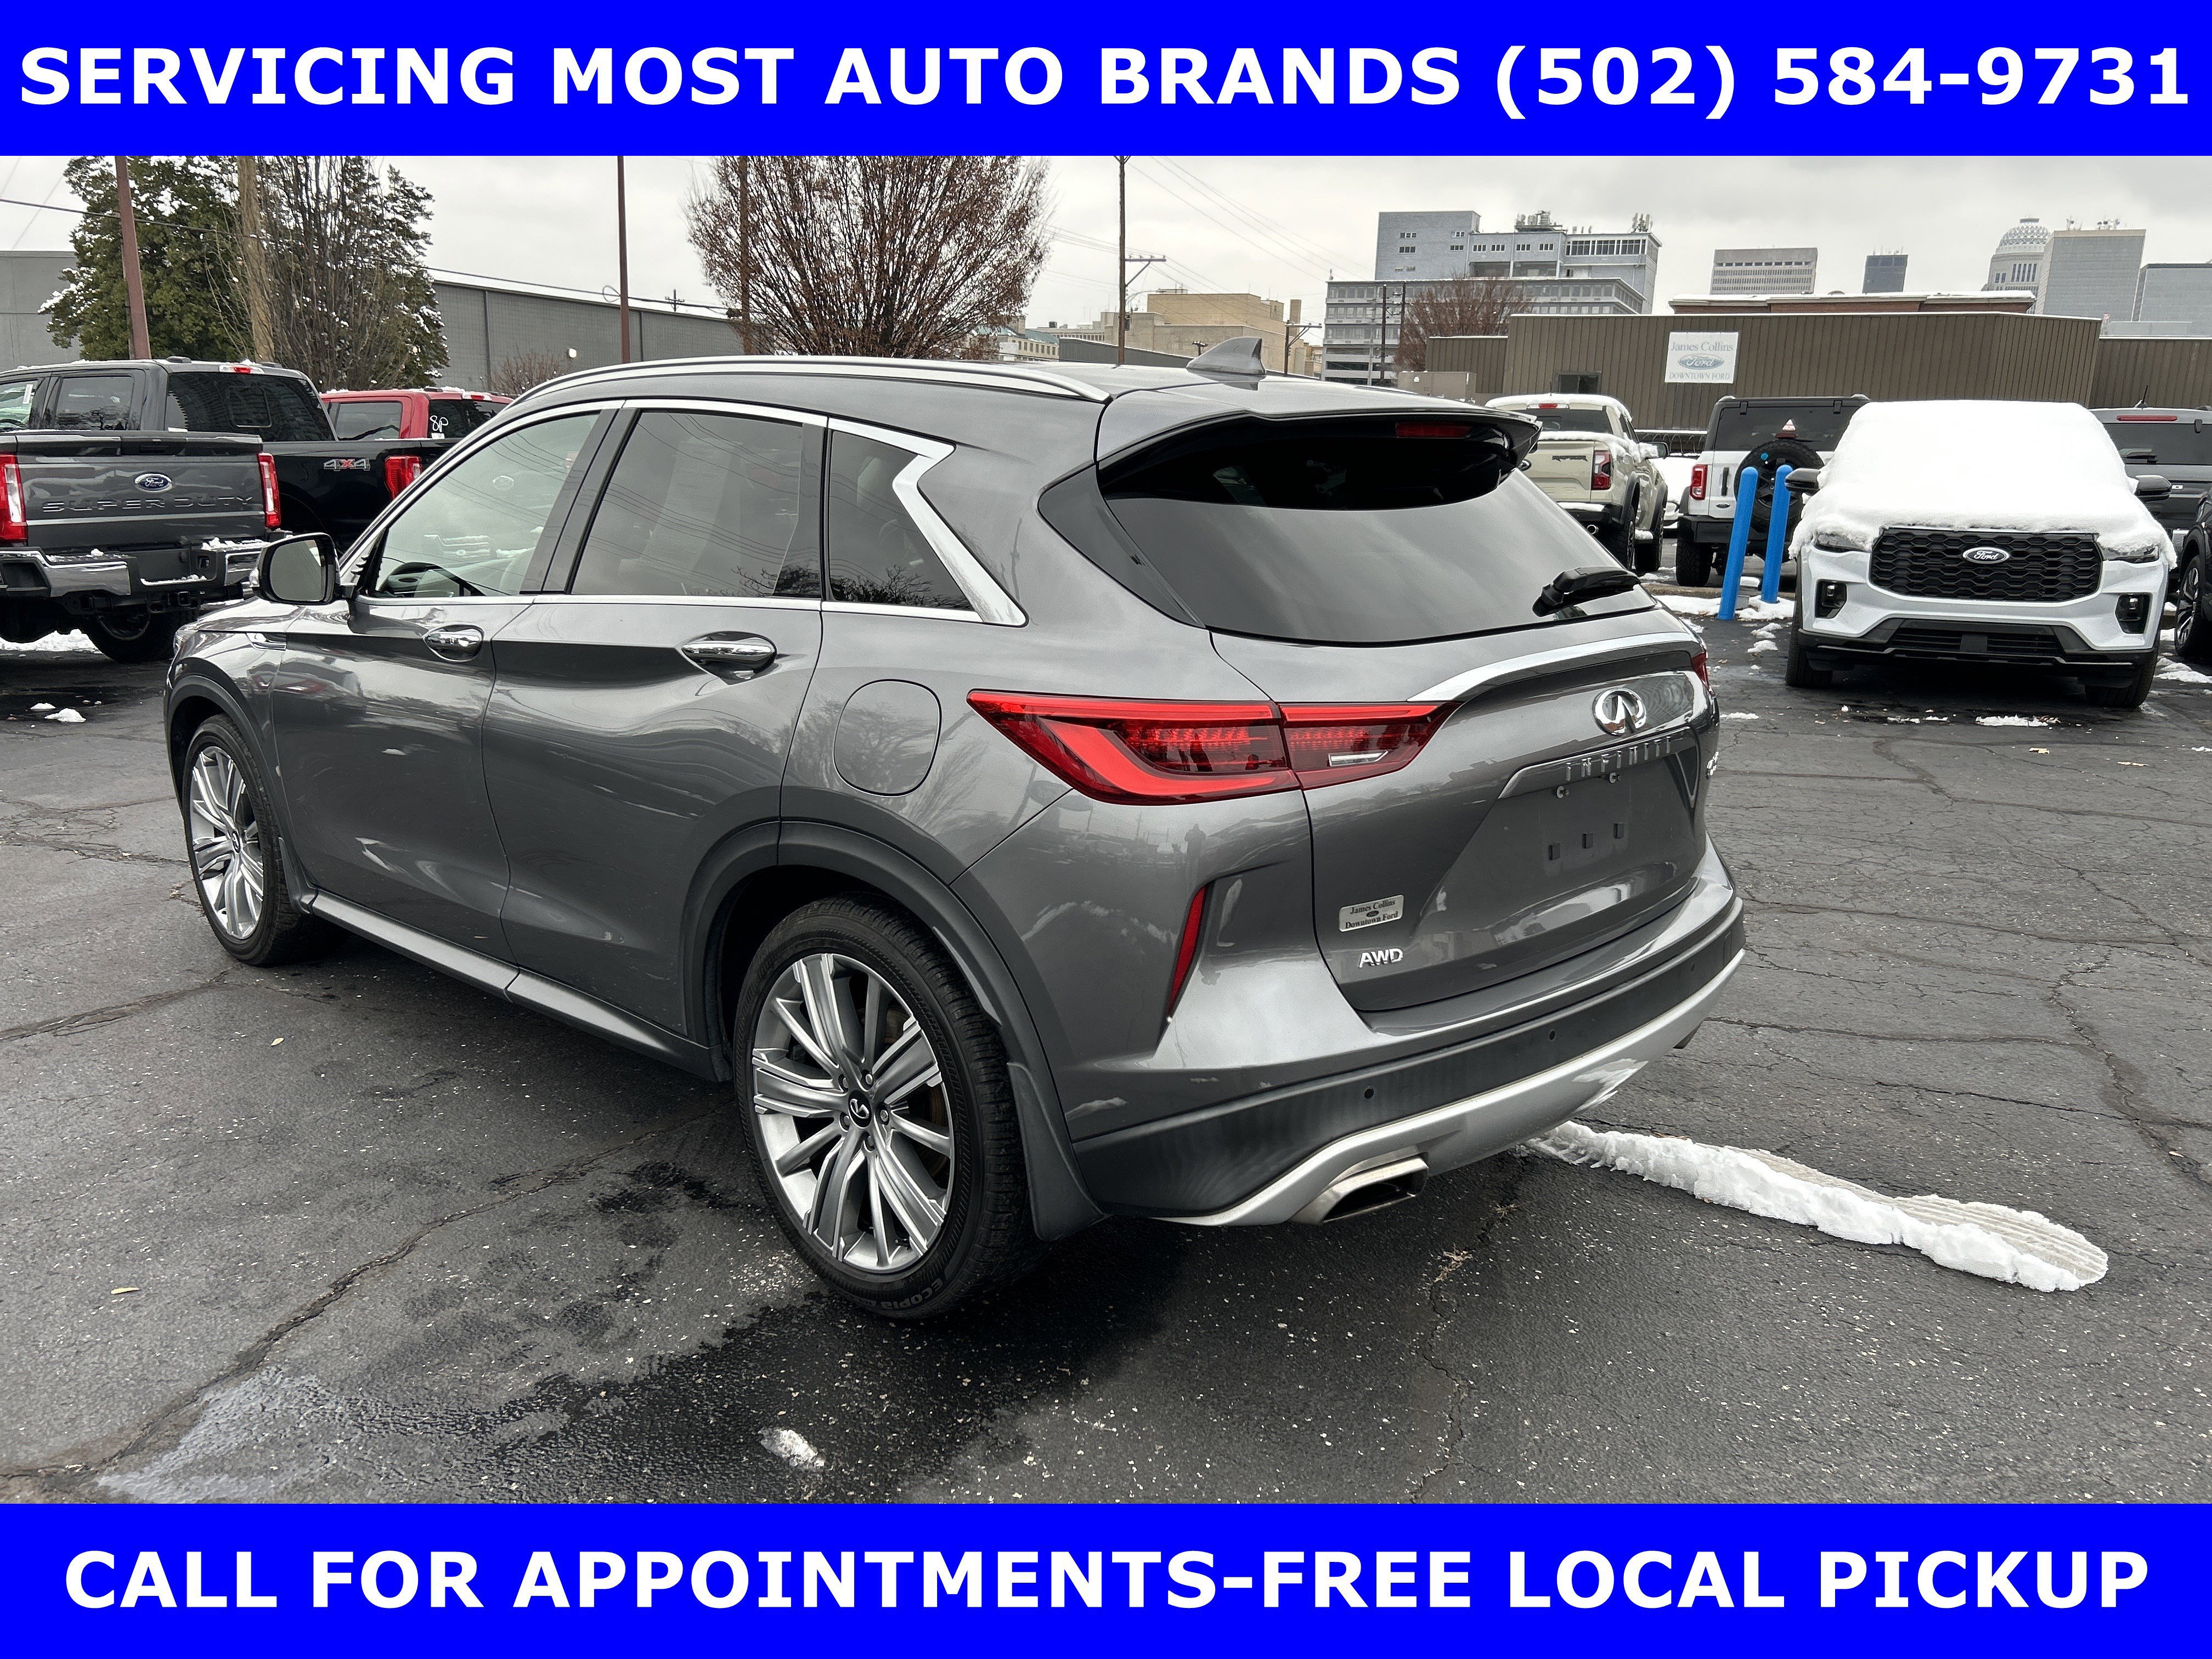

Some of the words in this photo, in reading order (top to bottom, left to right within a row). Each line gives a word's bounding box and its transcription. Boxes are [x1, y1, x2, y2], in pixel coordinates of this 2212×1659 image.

[1671, 342, 1699, 352] James
[1701, 342, 1734, 352] Collins
[1686, 356, 1716, 367] Ford
[144, 477, 165, 487] Ford
[42, 498, 166, 513] SUPER
[174, 496, 253, 508] DUTY
[1973, 550, 2000, 560] Ford
[1565, 736, 1672, 781] INFINITI
[1350, 905, 1372, 915] James
[1373, 899, 1396, 910] Collins
[1345, 916, 1381, 929] Downtown
[1382, 911, 1399, 921] Ford
[1358, 948, 1403, 968] AWD
